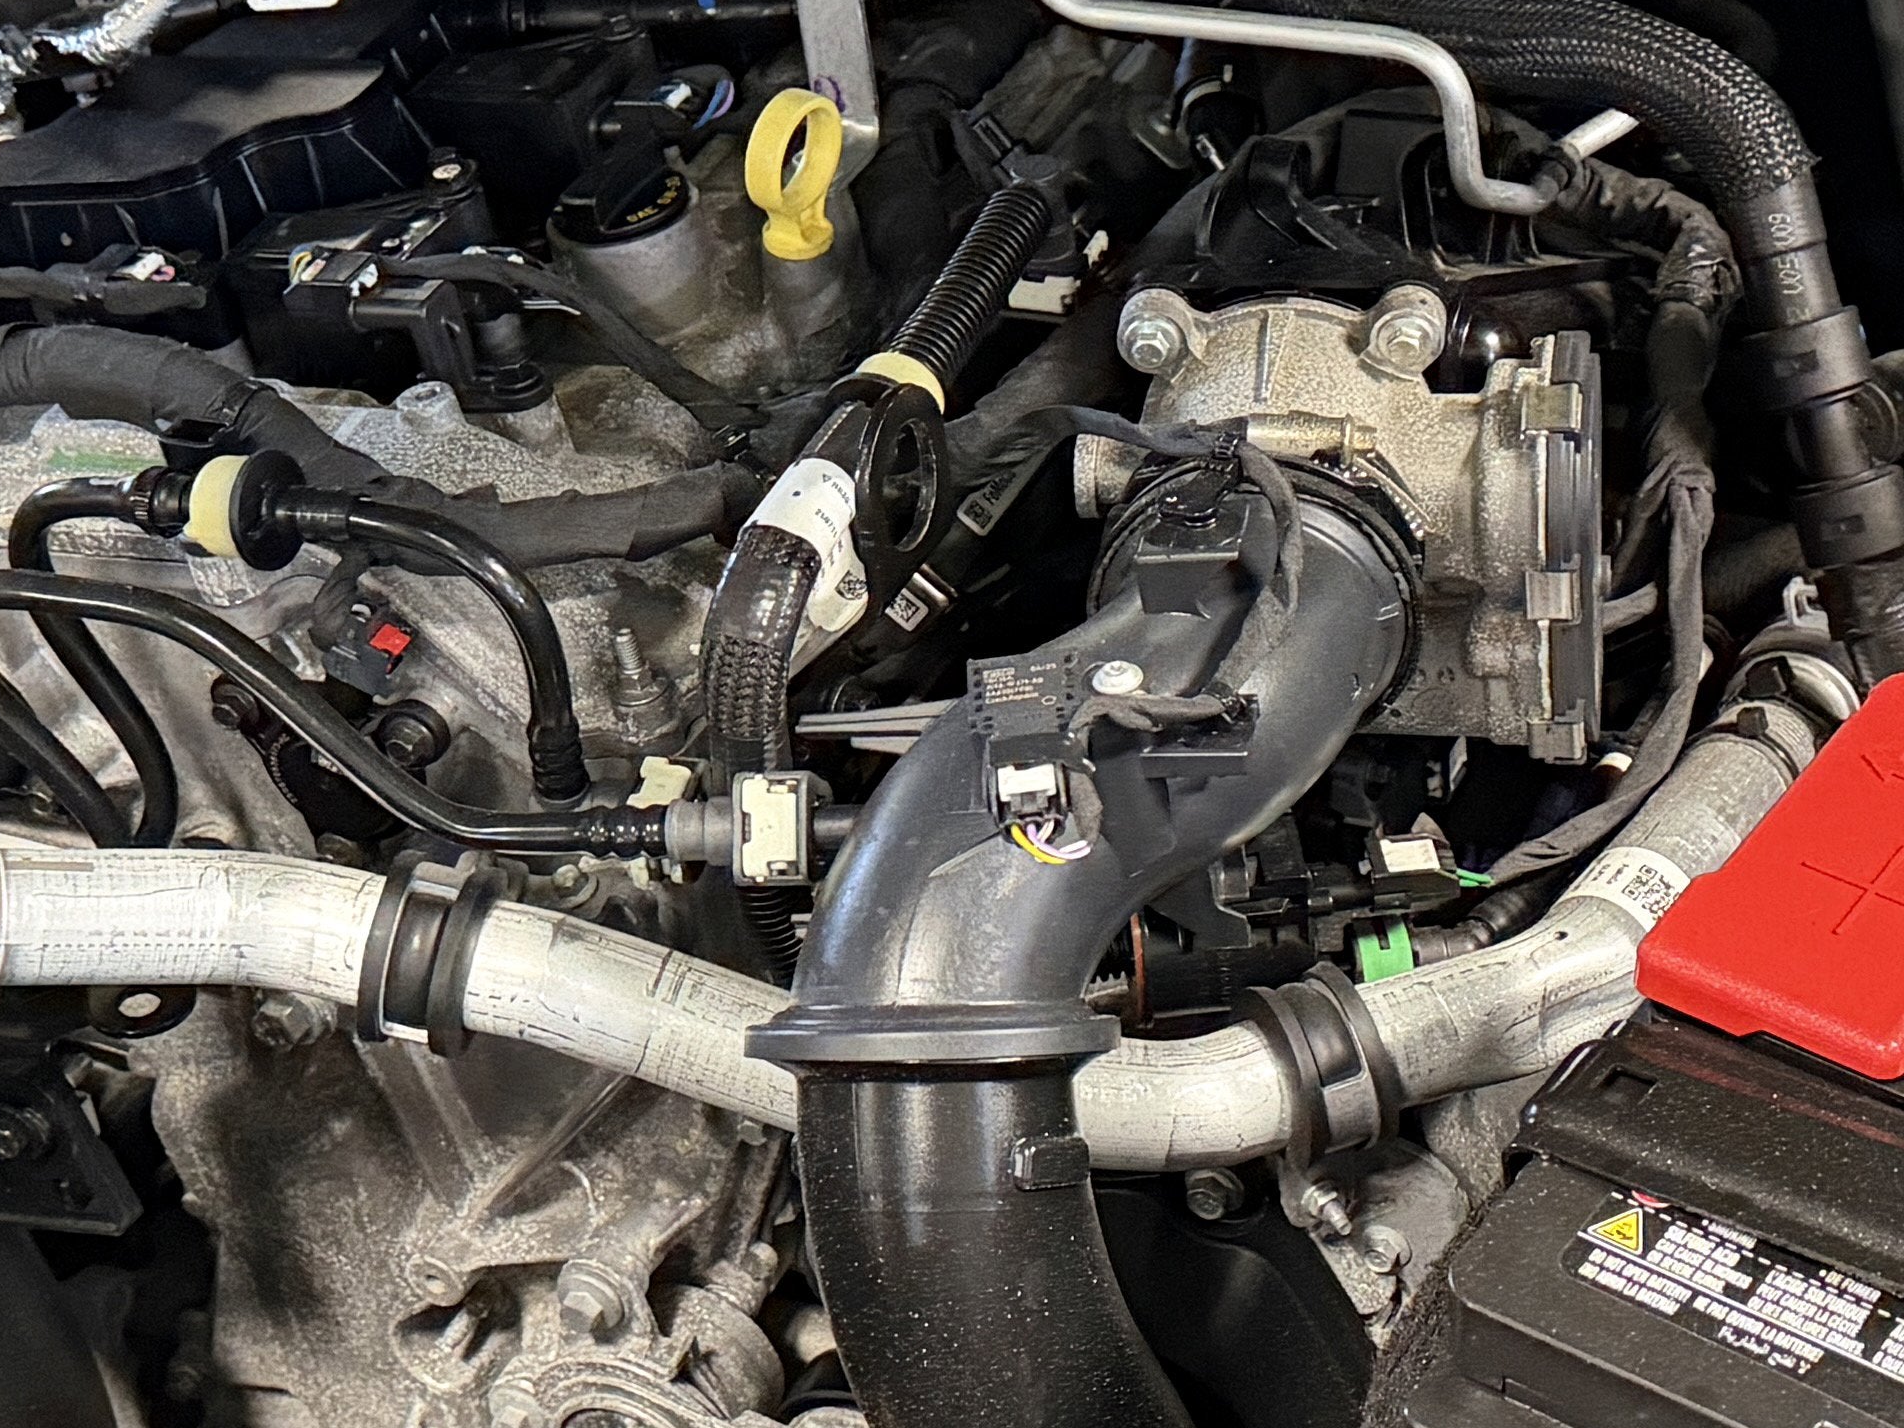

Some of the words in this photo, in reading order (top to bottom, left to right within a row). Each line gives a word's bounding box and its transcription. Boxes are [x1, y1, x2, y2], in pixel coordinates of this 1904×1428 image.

[1600, 1253, 1627, 1274] NOT
[1619, 1262, 1651, 1284] OPEN
[1690, 1294, 1712, 1312] NE
[1704, 1300, 1730, 1320] PAS
[1723, 1309, 1766, 1336] OUVRIR
[1758, 1324, 1779, 1342] LA
[1621, 1280, 1641, 1298] LA
[1754, 1281, 1784, 1302] PEUT
[1777, 1292, 1819, 1318] CAUSER
[1812, 1308, 1832, 1324] LA
[1839, 1276, 1882, 1304] FUMER
